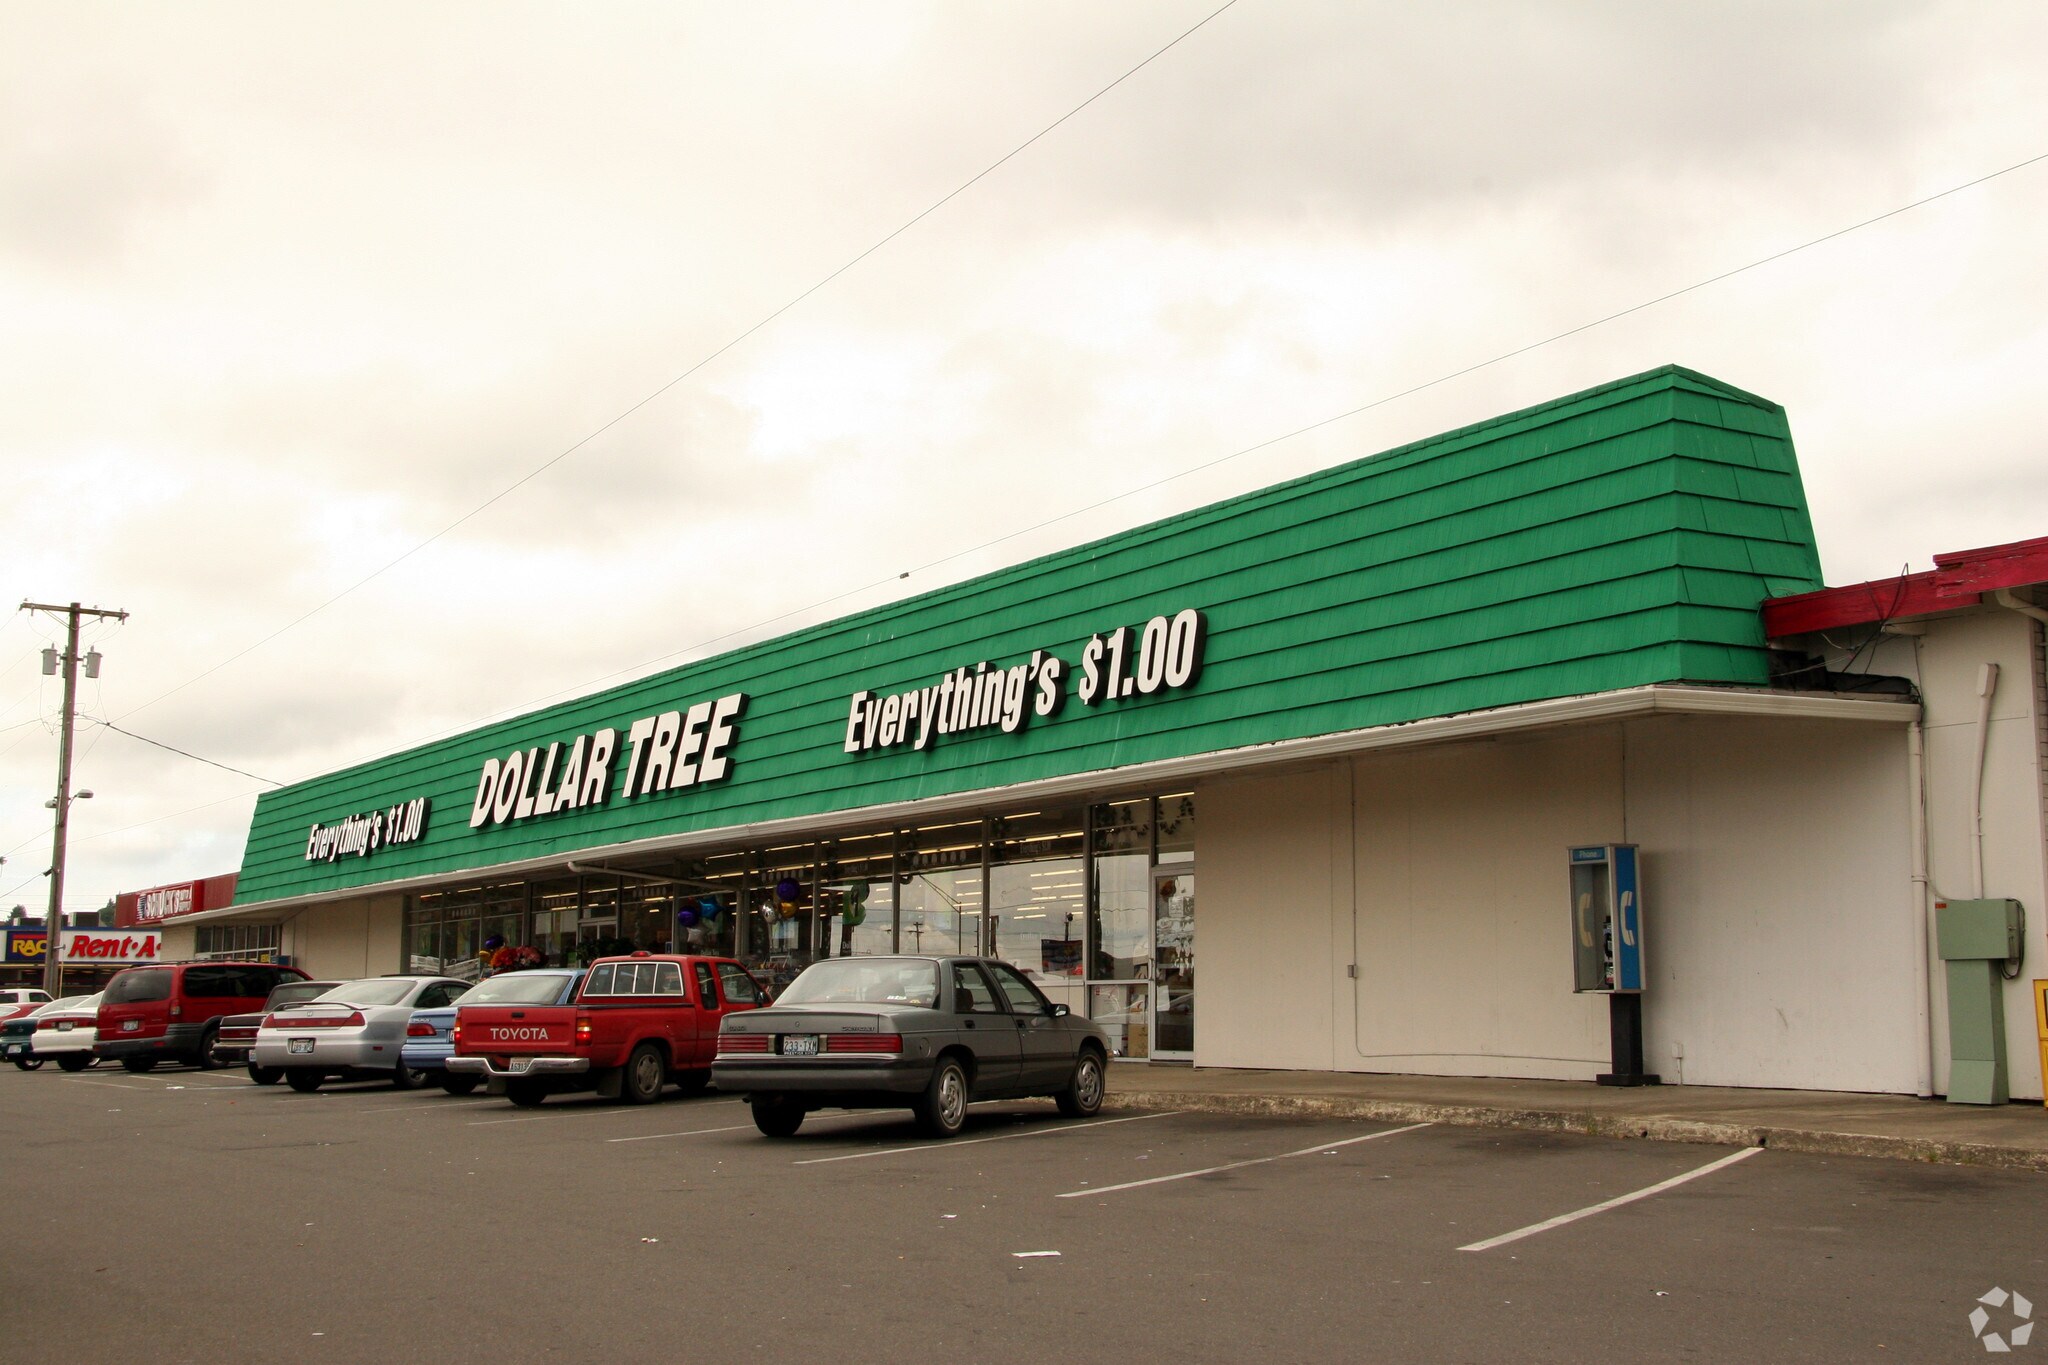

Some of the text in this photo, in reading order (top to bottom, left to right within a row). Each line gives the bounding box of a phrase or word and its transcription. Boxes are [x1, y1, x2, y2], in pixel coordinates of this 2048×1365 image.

[844, 608, 1203, 753] Everything's $1.00
[469, 692, 747, 828] DOLLAR TREE
[305, 796, 428, 863] Everything's $1.00
[490, 1028, 549, 1040] TOYOTA
